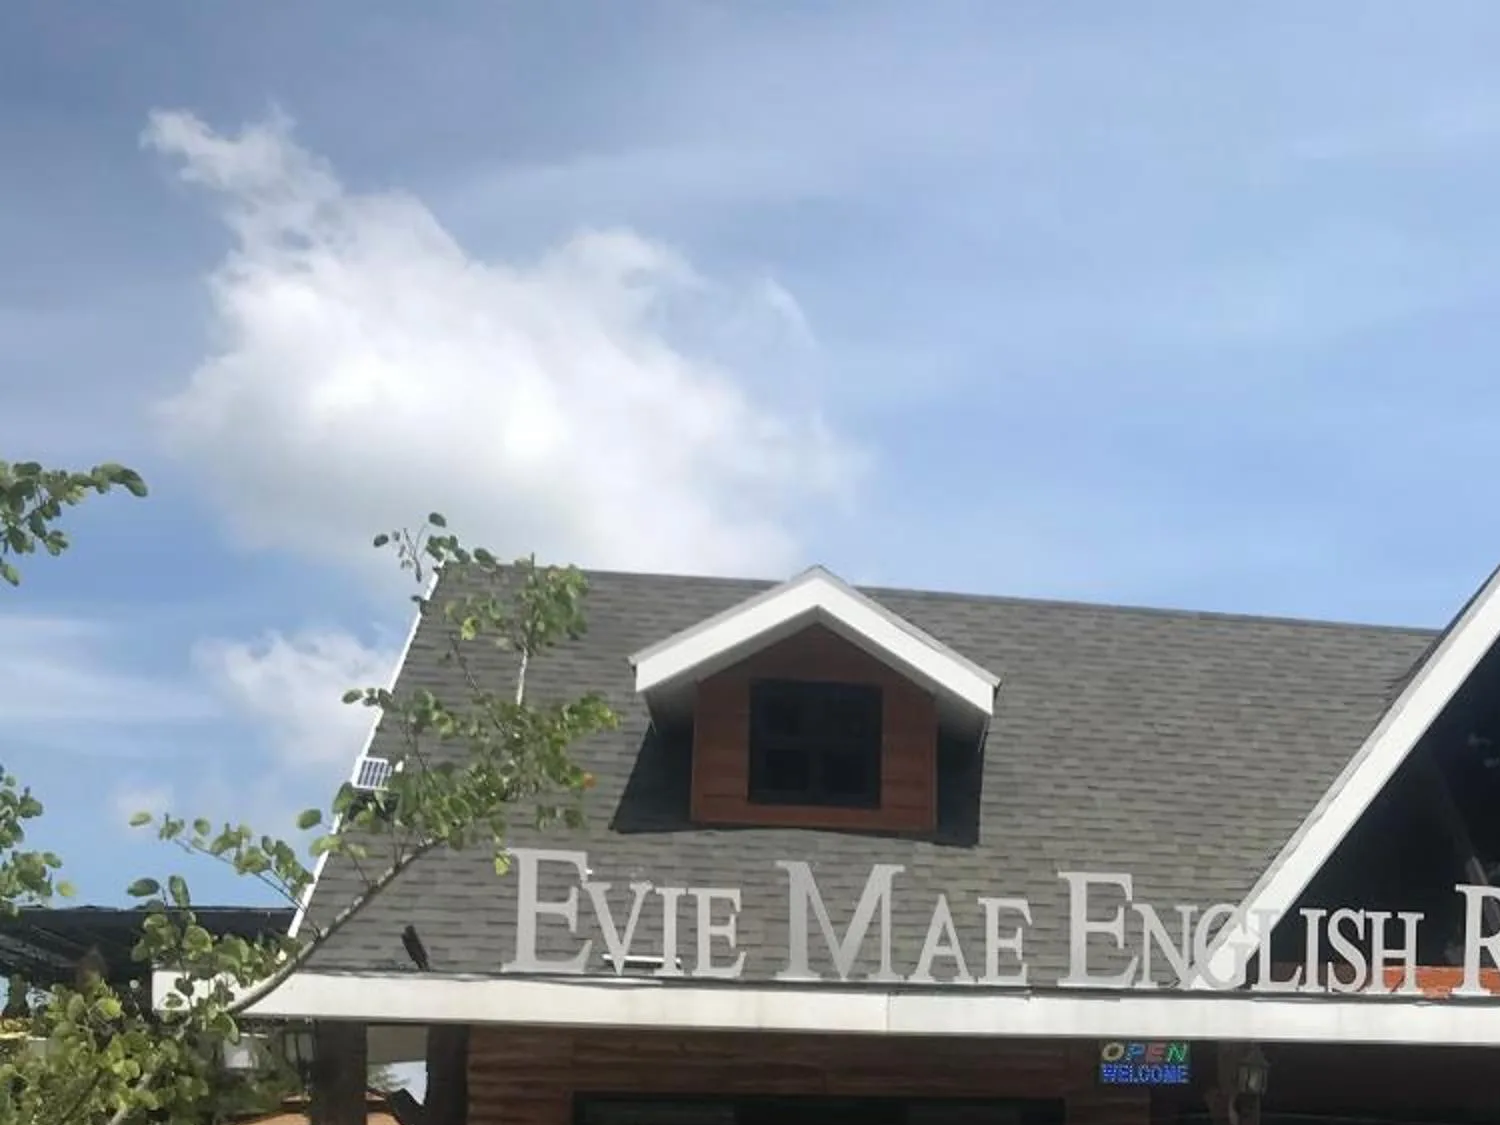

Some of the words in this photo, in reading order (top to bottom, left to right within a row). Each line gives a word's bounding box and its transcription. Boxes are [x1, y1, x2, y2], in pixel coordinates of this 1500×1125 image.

[501, 847, 746, 978] EVIE
[775, 860, 1031, 985] MAE
[1057, 871, 1424, 997] ENGLISH
[1102, 1042, 1188, 1062] OPEN
[1102, 1064, 1189, 1083] WELCOME
